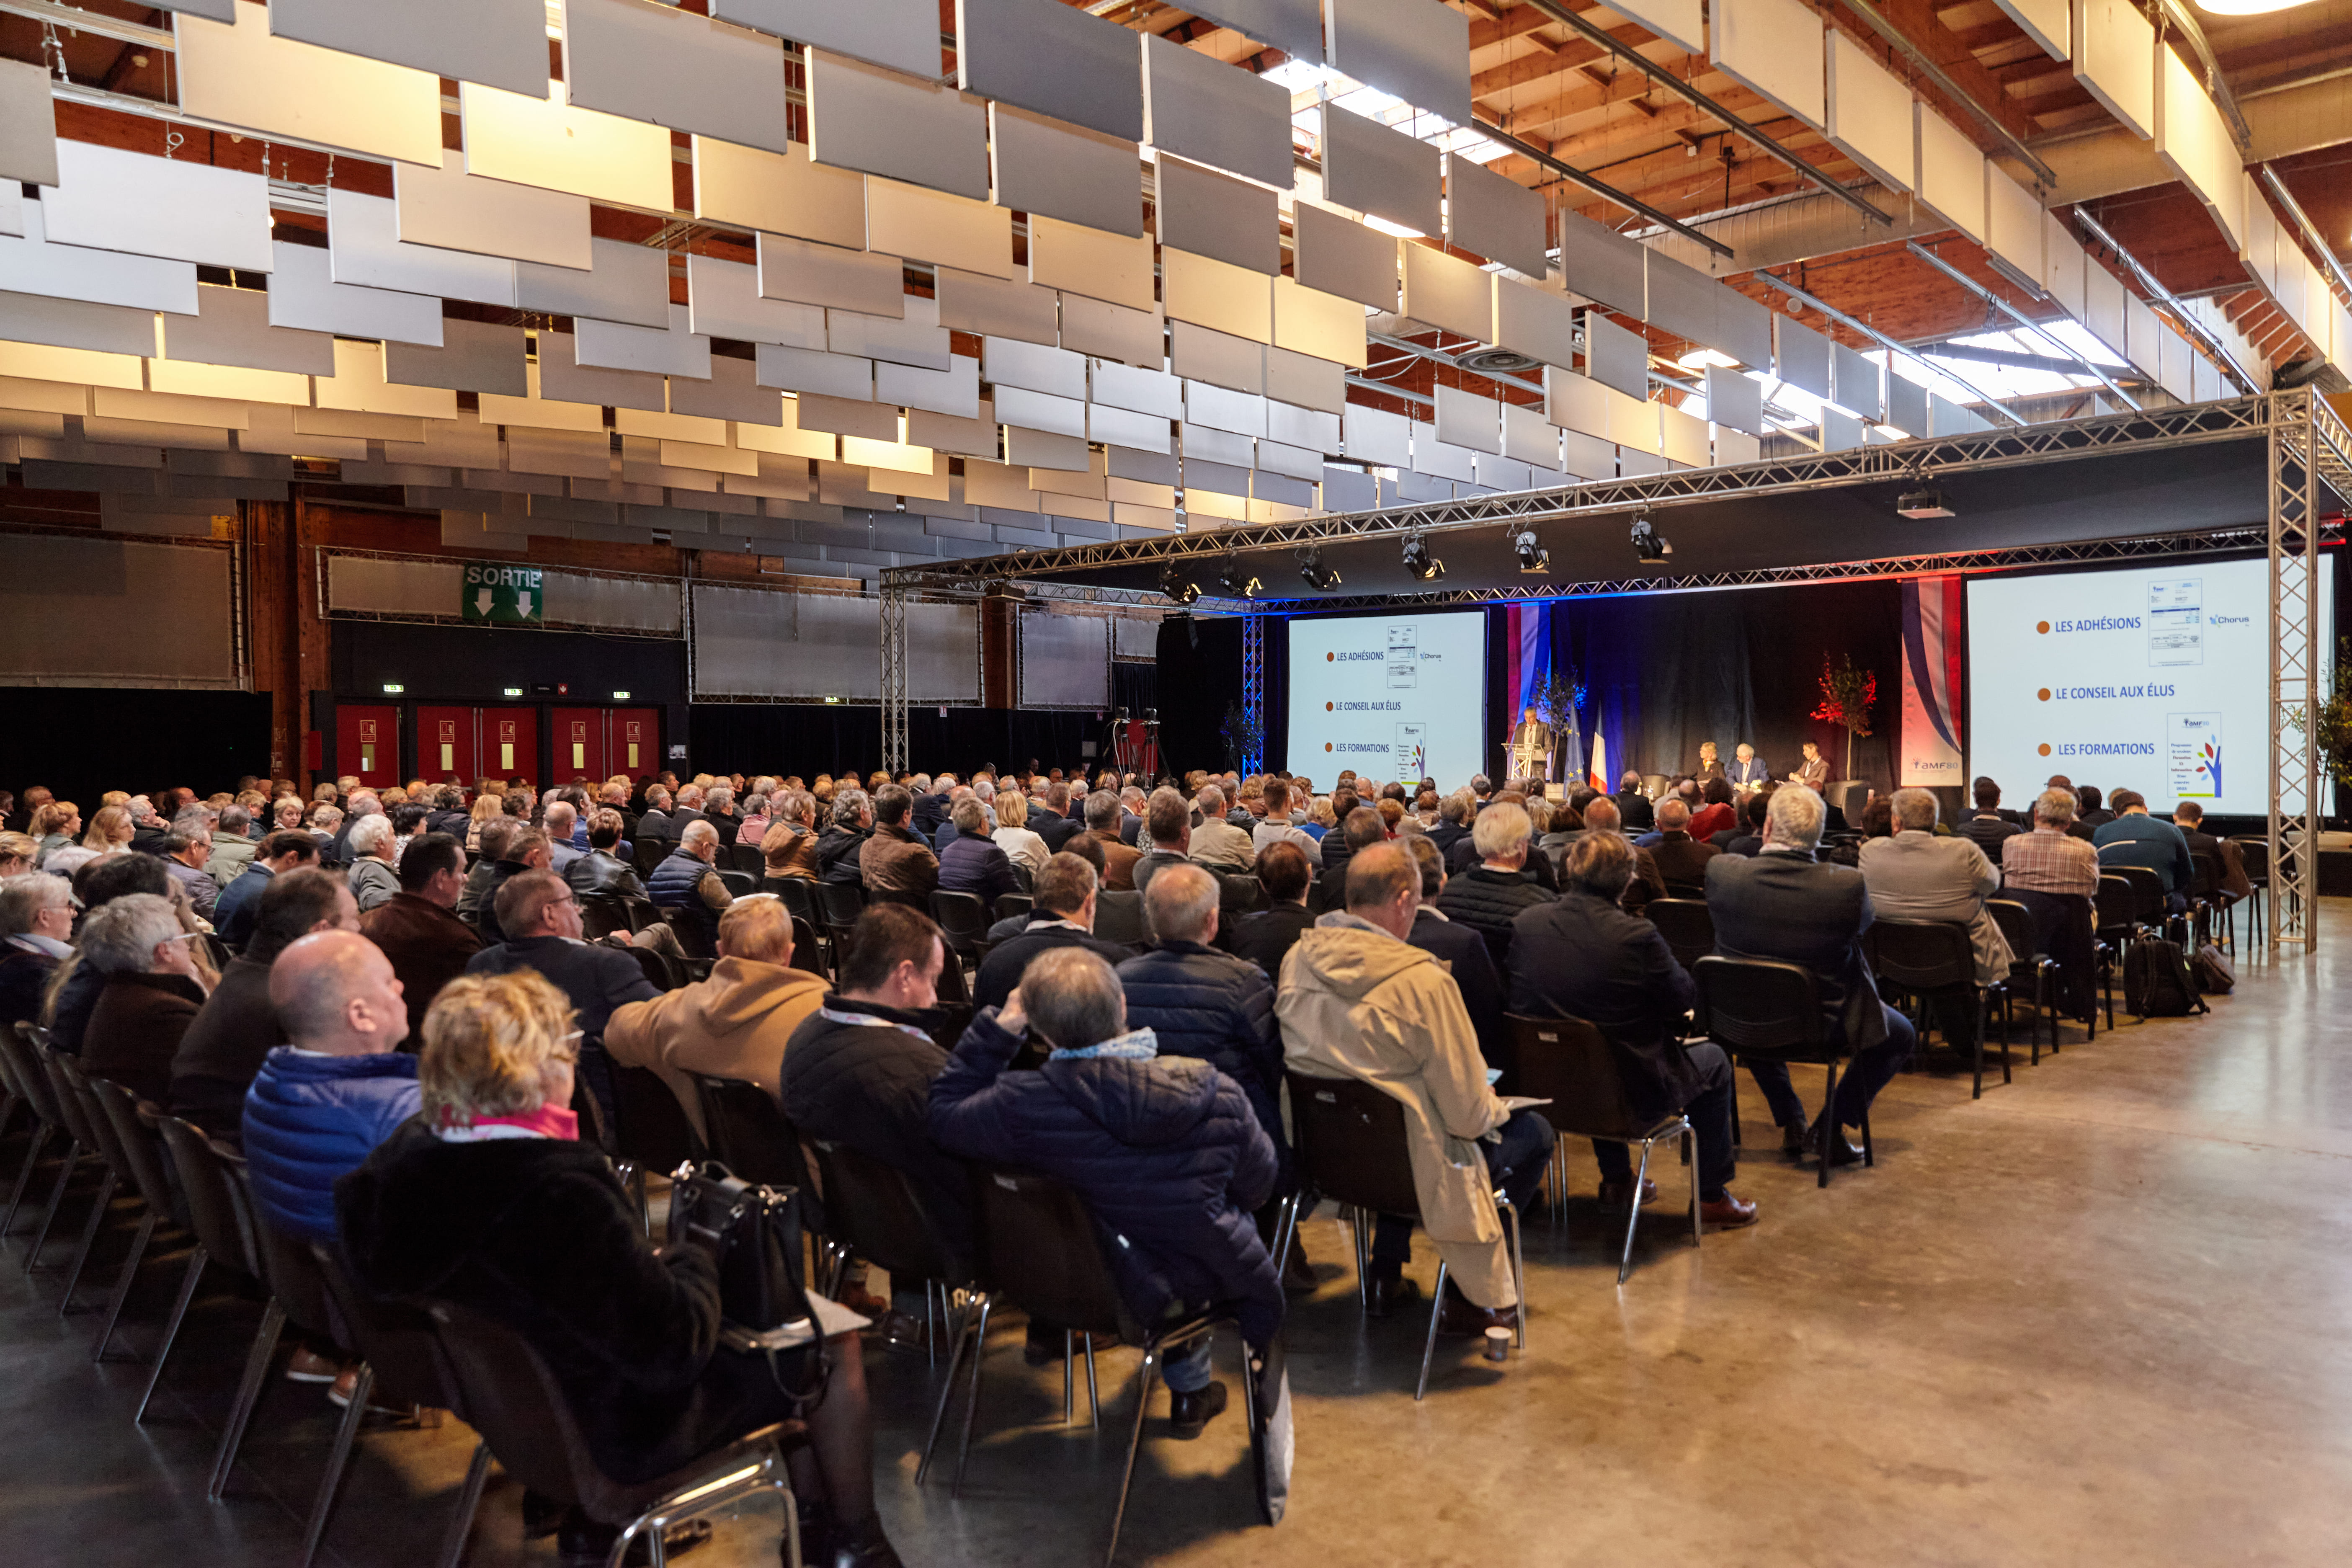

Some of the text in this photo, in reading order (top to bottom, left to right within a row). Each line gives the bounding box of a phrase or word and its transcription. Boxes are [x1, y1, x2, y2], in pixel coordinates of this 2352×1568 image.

[467, 566, 541, 588] SORTIE
[2055, 616, 2141, 632] LES ADHÉSIONS
[1337, 652, 1347, 661] LES
[1348, 650, 1384, 660] ADHÉSIONS
[2056, 682, 2174, 699] LE CONSEIL AUX ÉLUS
[1336, 700, 1401, 711] LE CONSEIL AUX ÉLUS
[1336, 743, 1389, 753] LES FORMATIONS
[2059, 743, 2154, 755] LES FORMATIONS
